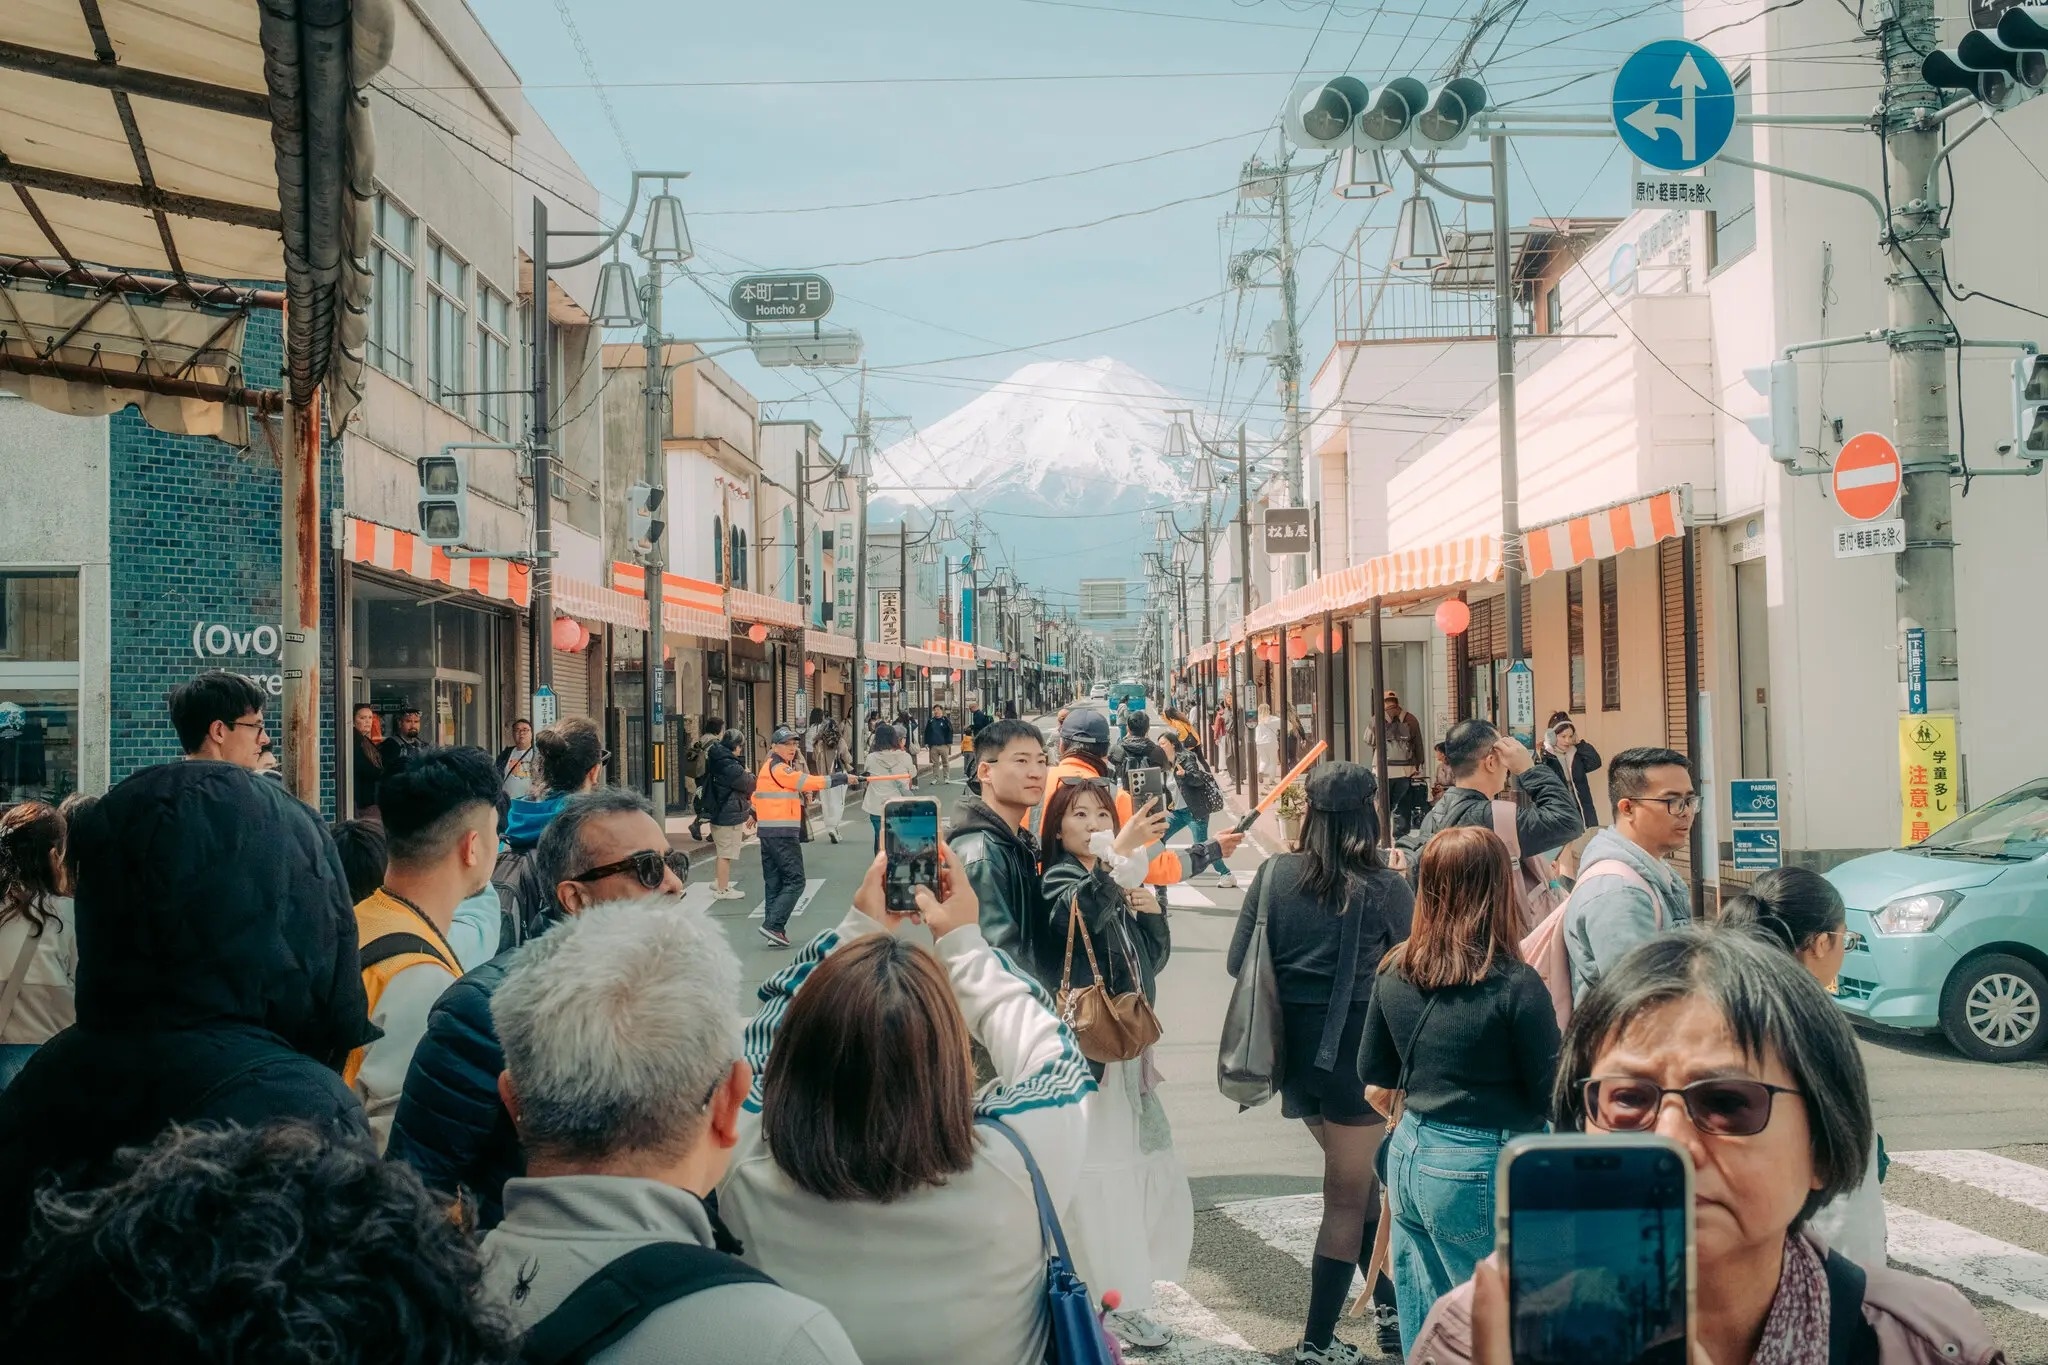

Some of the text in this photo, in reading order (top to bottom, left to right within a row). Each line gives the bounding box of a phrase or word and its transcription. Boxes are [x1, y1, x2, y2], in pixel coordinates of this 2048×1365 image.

[1636, 182, 1711, 203] 原付・軽車両を除く
[740, 281, 820, 303] 本町二丁目
[755, 303, 807, 315] Honcho 2
[1838, 527, 1902, 551] 原付・軽車両を除く
[836, 522, 855, 629] 日川時計店
[881, 592, 898, 645] 富士急ハイラン
[1913, 693, 1921, 705] 6
[1932, 750, 1948, 812] 学童多し
